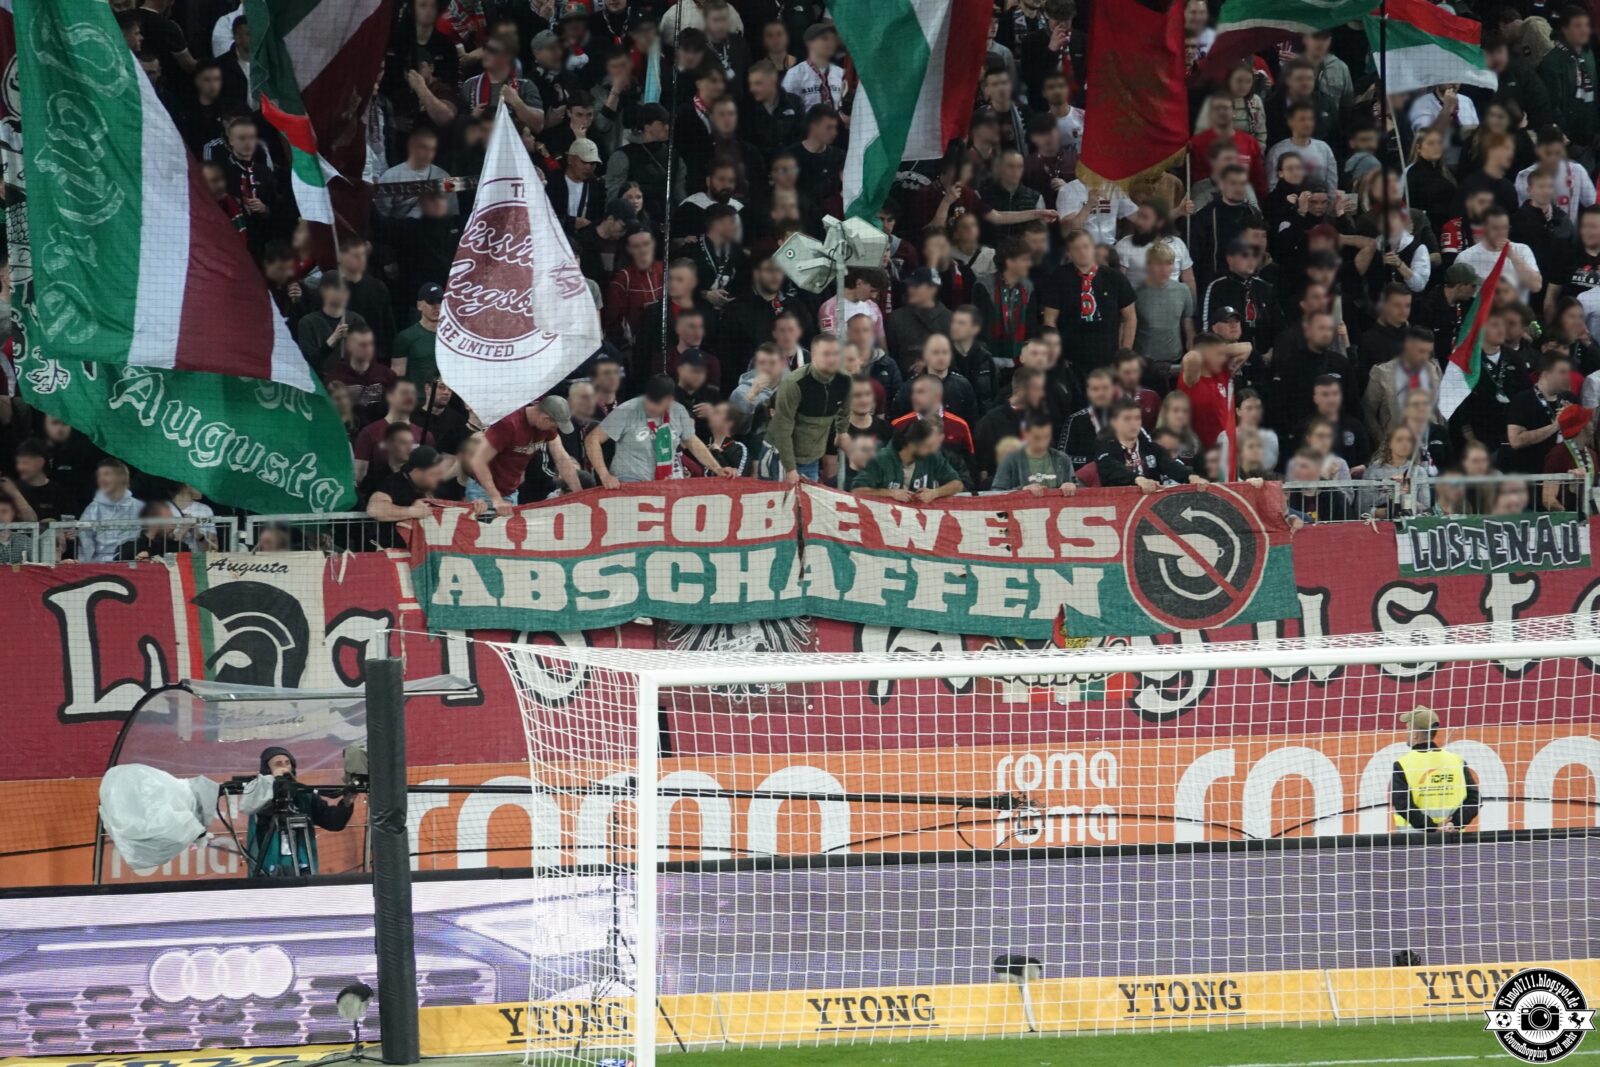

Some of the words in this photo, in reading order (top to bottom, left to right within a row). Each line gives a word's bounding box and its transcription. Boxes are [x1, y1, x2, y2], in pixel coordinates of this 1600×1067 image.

[457, 337, 515, 358] UNITED
[108, 367, 345, 514] Augusta
[421, 483, 1122, 559] VIDEOBEWEIS
[1409, 515, 1582, 573] LUSTENAU
[206, 558, 289, 575] Augusta
[432, 547, 1104, 620] ABSCHAFFEN
[997, 752, 1119, 793] roma
[997, 805, 1119, 845] roma
[808, 994, 936, 1026] YTONG
[1118, 980, 1243, 1013] YTONG
[500, 1003, 629, 1037] YTONG
